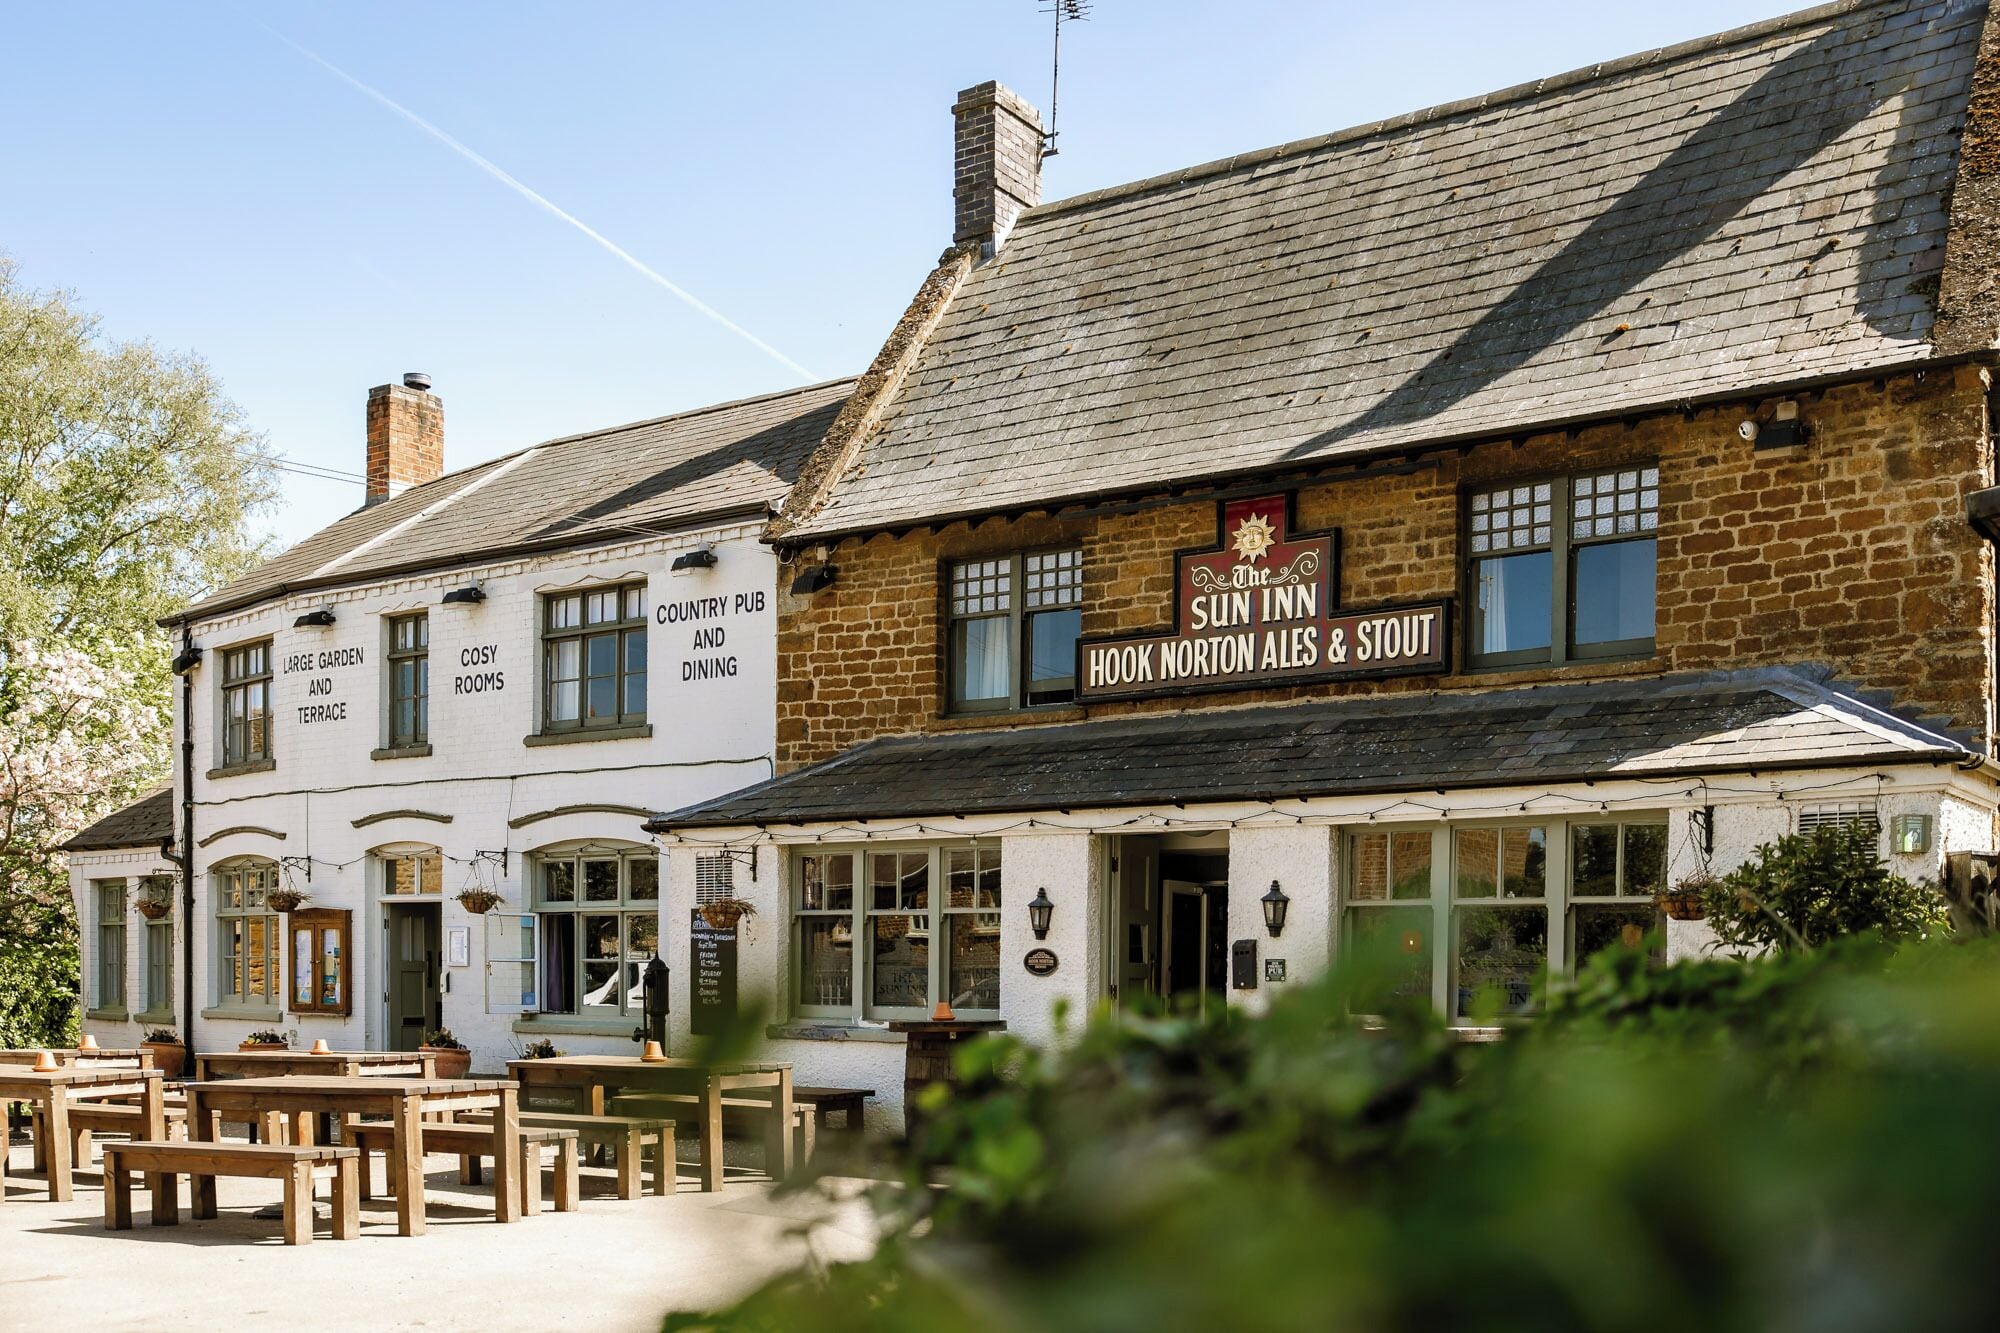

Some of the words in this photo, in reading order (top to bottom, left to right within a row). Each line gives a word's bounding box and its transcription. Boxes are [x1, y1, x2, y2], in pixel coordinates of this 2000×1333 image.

[1231, 563, 1271, 589] The
[656, 595, 728, 625] COUNTRY
[735, 590, 765, 615] PUB
[1191, 590, 1252, 630] SUN
[1260, 582, 1318, 622] INN
[693, 626, 725, 651] AND
[1089, 643, 1154, 687] HOOK
[1160, 631, 1255, 680] NORTON
[1260, 625, 1318, 670] ALES
[1327, 627, 1347, 663] &
[1356, 613, 1434, 661] STOUT
[283, 654, 315, 675] LARGE
[318, 646, 364, 670] GARDEN
[460, 644, 498, 667] COSY
[682, 656, 737, 682] DINING
[308, 677, 332, 697] AND
[455, 671, 505, 695] ROOMS
[297, 702, 347, 724] TERRACE
[699, 951, 717, 959] FRIDAY
[700, 969, 722, 977] SATURDAY
[878, 984, 902, 994] SUN
